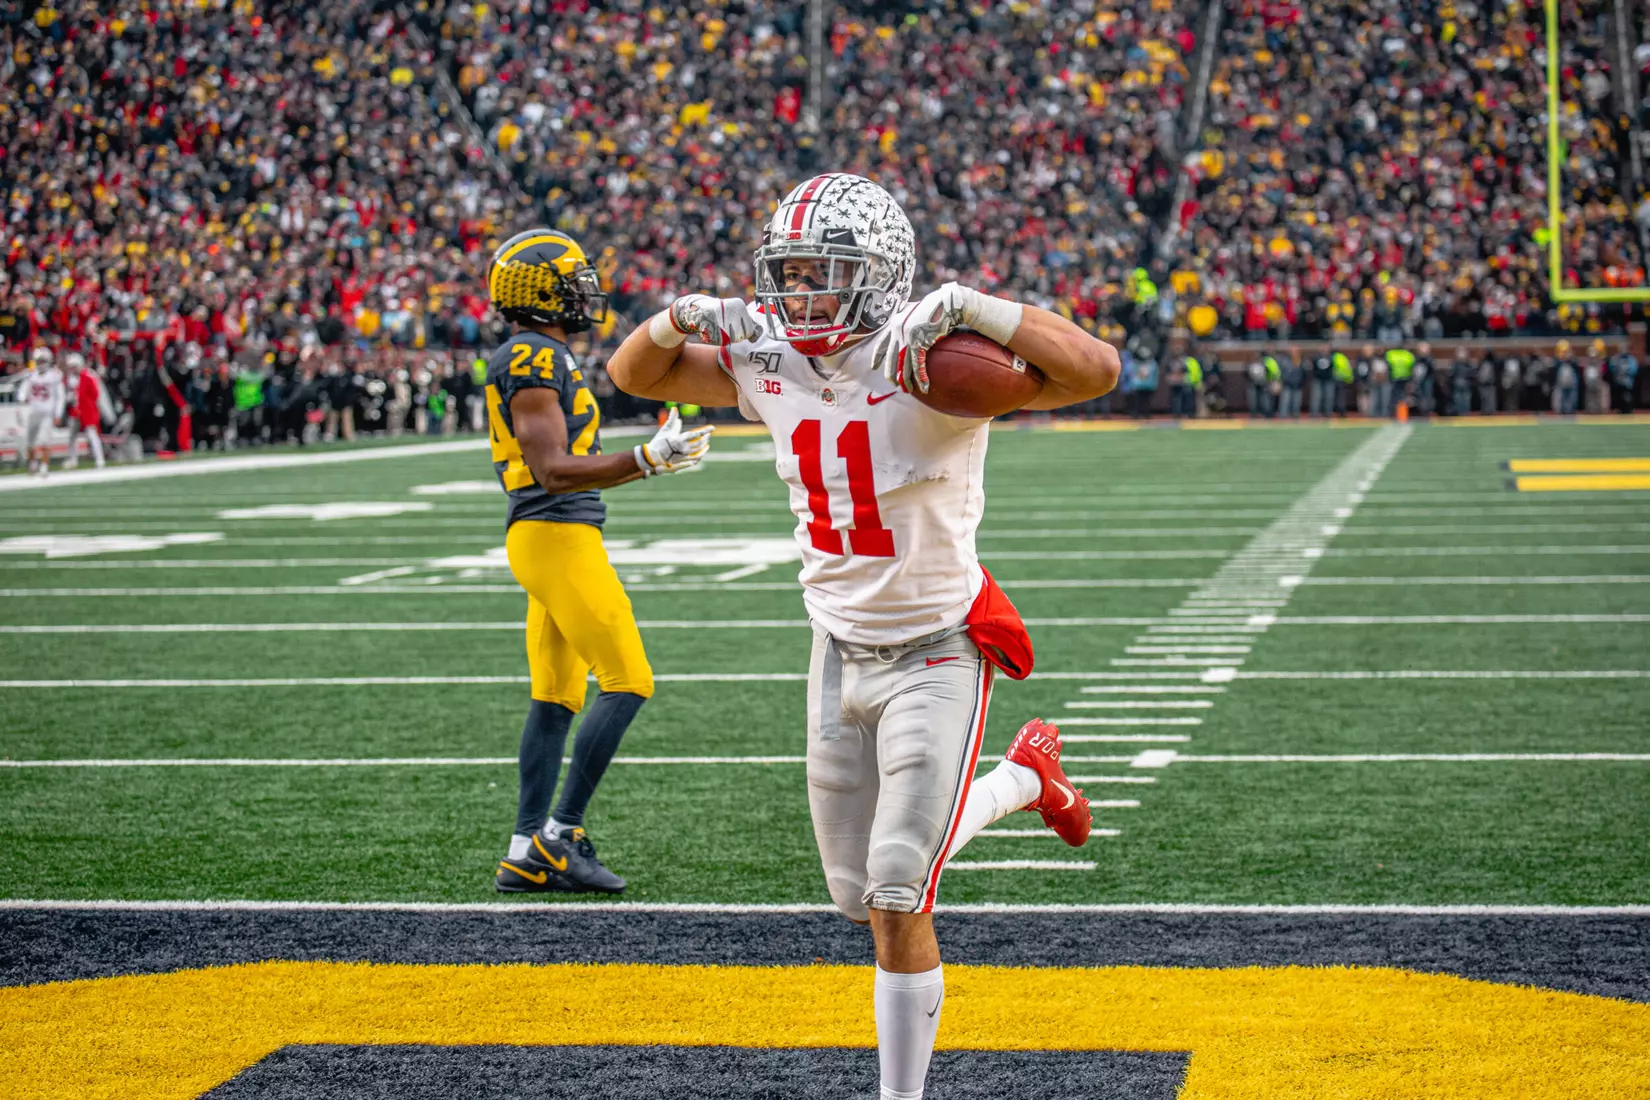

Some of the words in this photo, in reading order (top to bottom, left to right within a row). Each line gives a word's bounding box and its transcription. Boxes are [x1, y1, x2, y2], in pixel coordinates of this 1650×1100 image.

[510, 343, 554, 379] 24
[748, 351, 782, 374] 150
[791, 419, 896, 557] 11
[1028, 731, 1061, 761] POR
